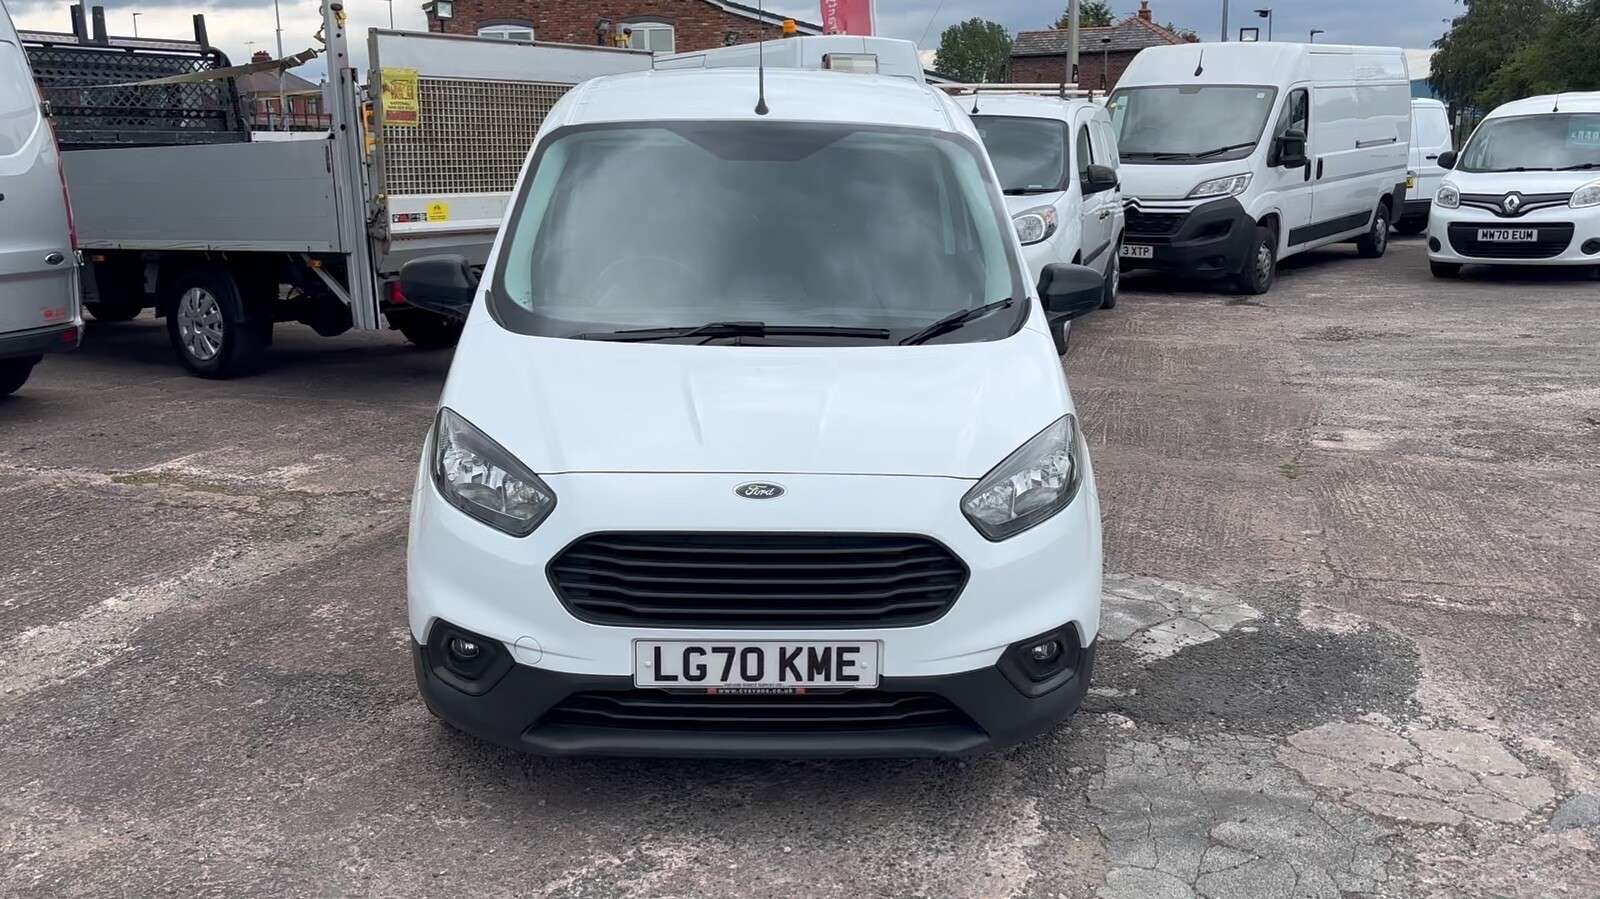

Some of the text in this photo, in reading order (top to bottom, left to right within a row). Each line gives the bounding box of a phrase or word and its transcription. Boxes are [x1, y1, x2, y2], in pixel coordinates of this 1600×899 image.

[1512, 230, 1534, 240] EUM
[1131, 246, 1150, 256] XTP
[744, 484, 776, 496] Ford
[653, 645, 861, 682] LG70 KME
